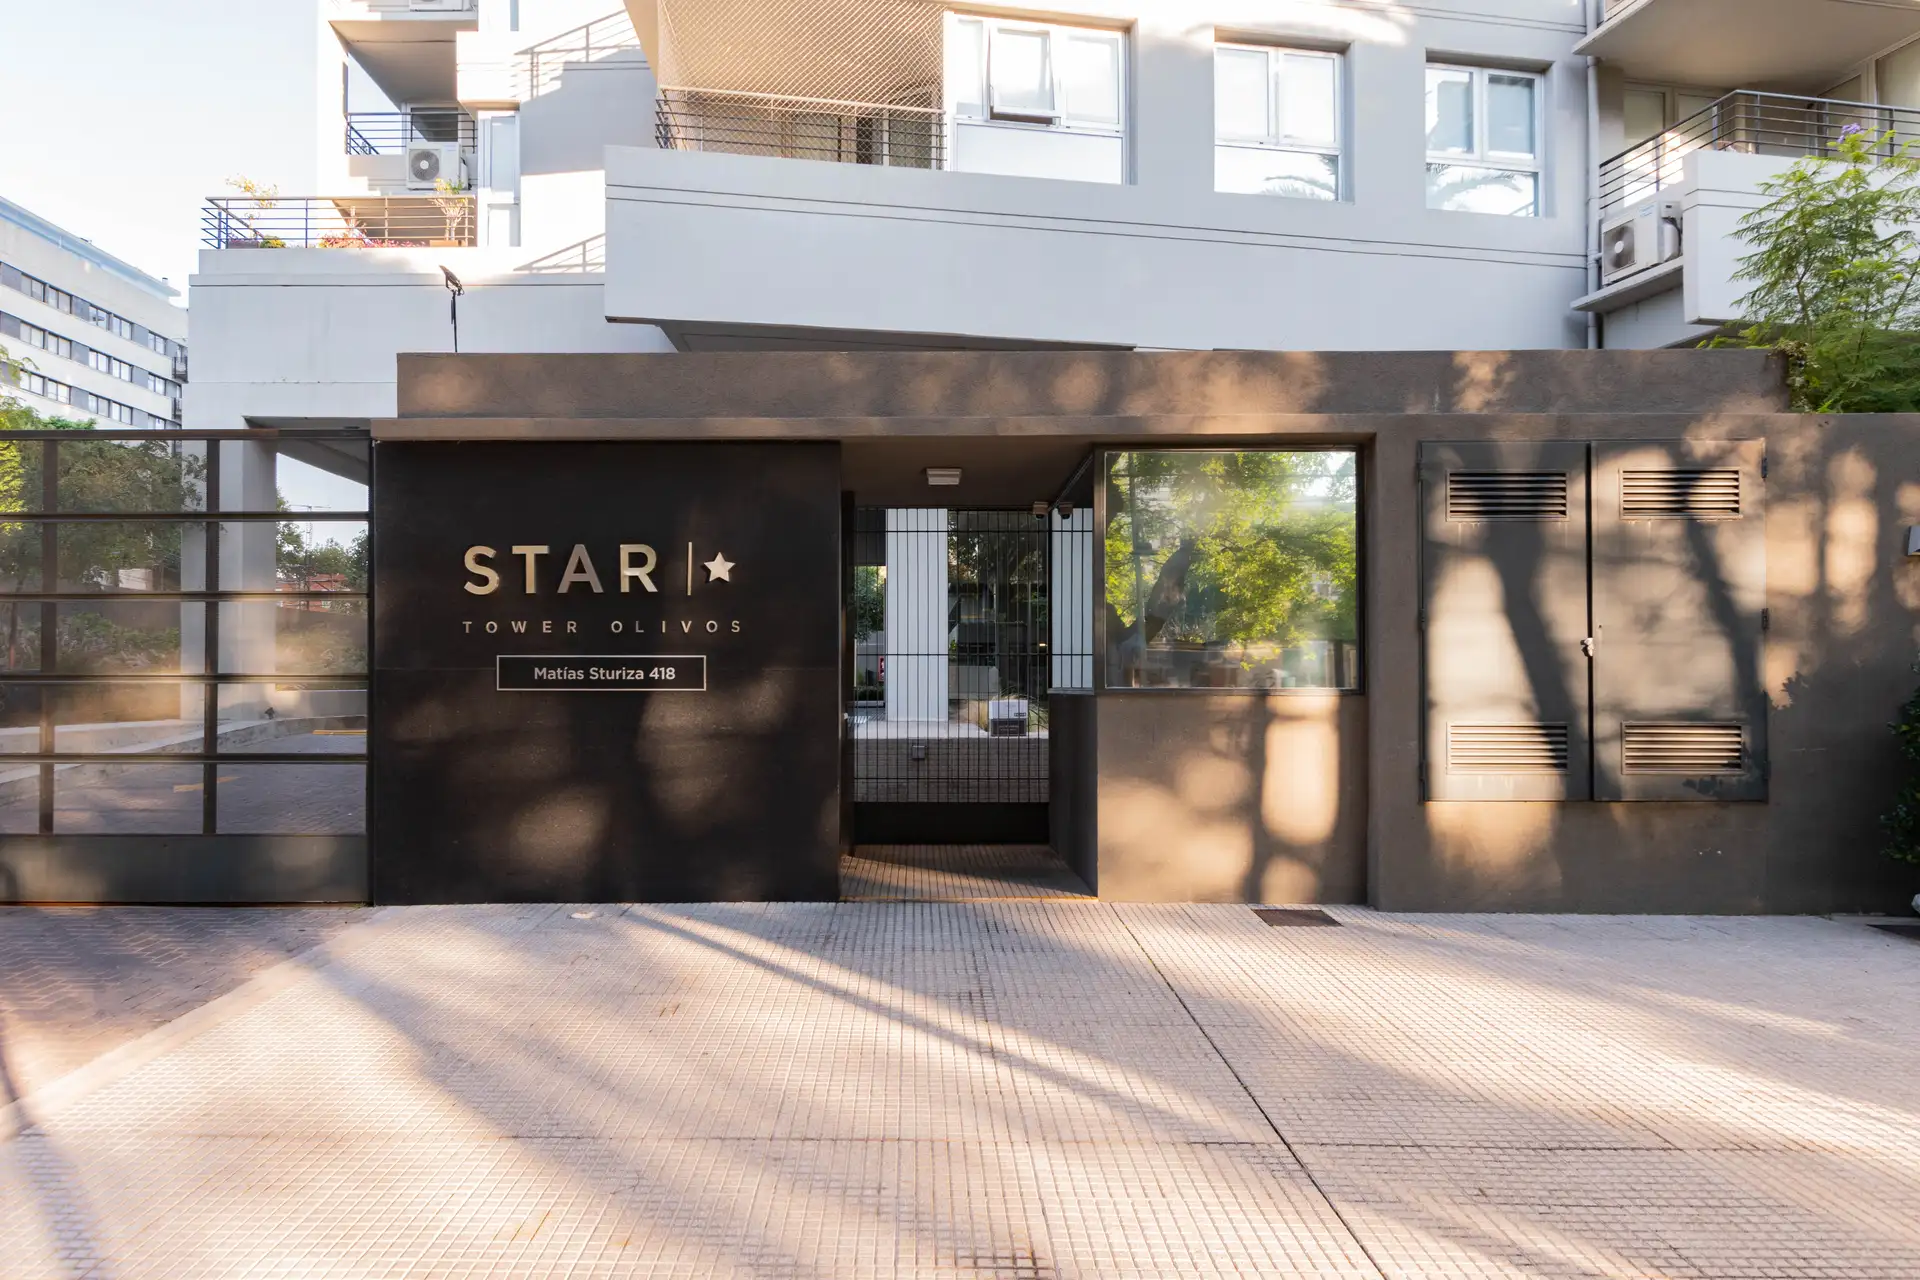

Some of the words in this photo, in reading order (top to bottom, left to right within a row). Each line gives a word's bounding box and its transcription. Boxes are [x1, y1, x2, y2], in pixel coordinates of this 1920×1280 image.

[463, 543, 659, 596] STAR
[462, 620, 578, 634] TOWER
[610, 620, 741, 634] OLIVOS
[534, 666, 585, 681] Matías
[589, 666, 645, 681] Sturiza
[648, 666, 676, 681] 418
